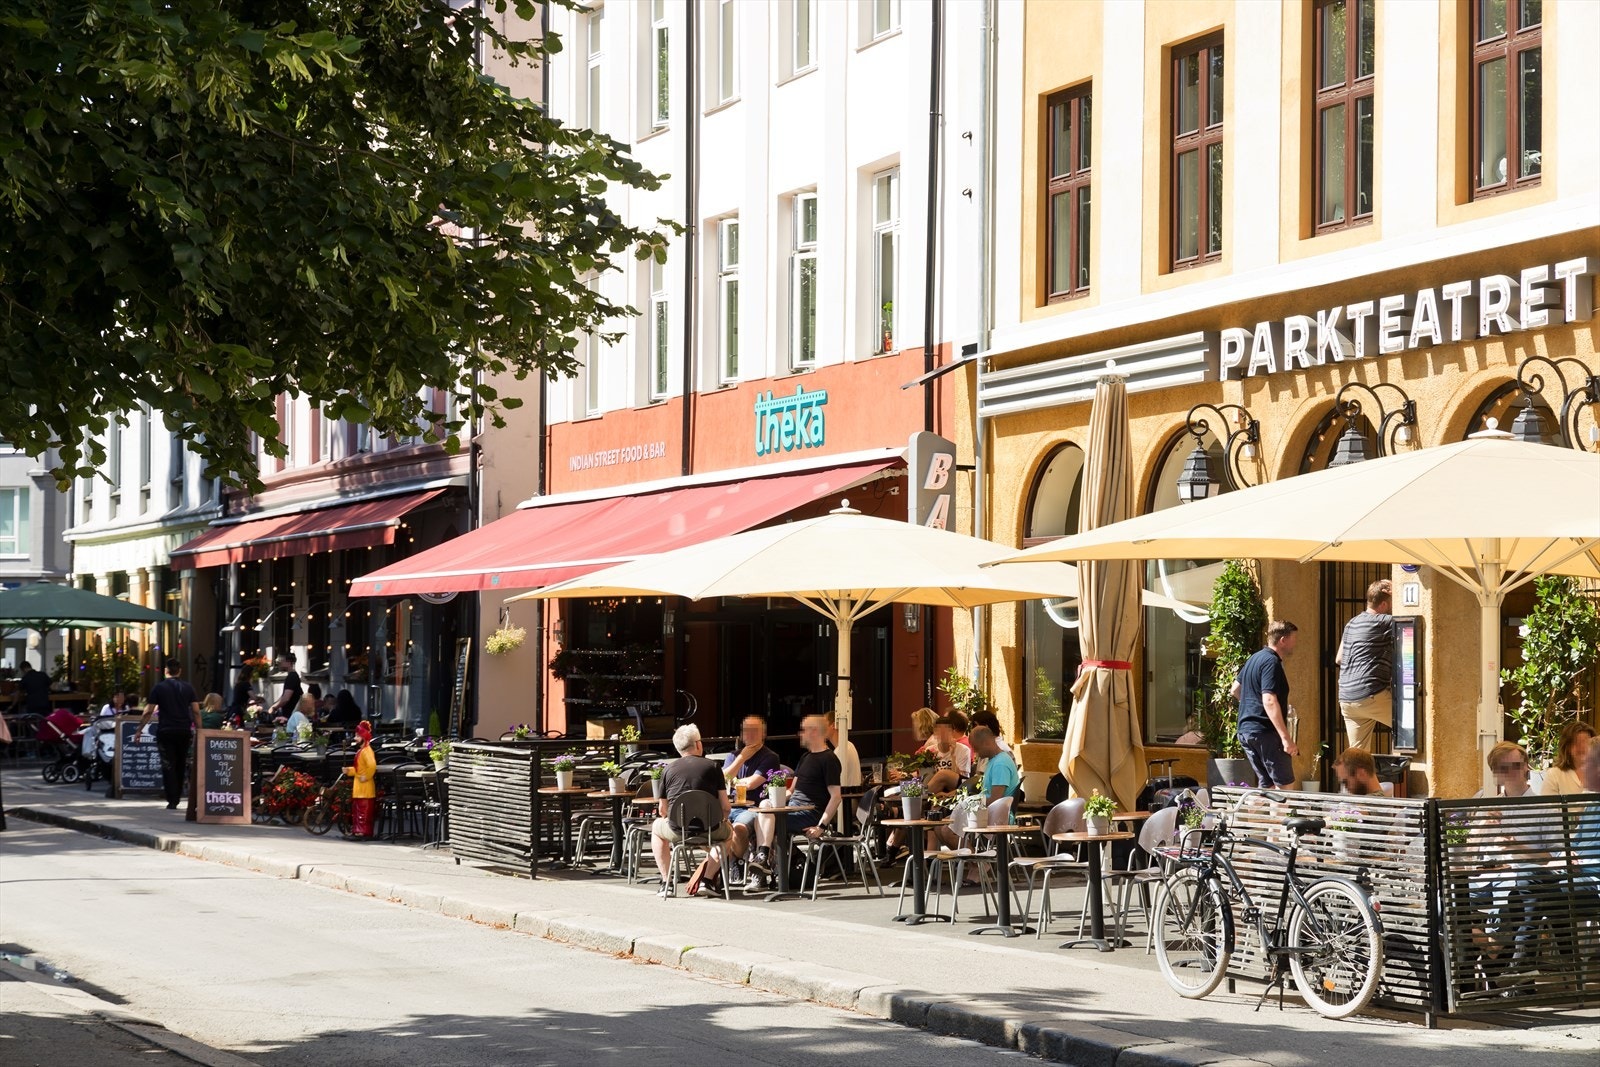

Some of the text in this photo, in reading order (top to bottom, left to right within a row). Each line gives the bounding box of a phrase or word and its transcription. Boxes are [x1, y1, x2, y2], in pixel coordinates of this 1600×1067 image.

[1219, 256, 1590, 382] PARKTEATRET
[755, 384, 828, 457] theka
[569, 441, 666, 472] INDIAN STREET FOOD & BAR
[1405, 586, 1415, 603] 11
[209, 740, 238, 750] DAGENS
[205, 791, 242, 804] theka
